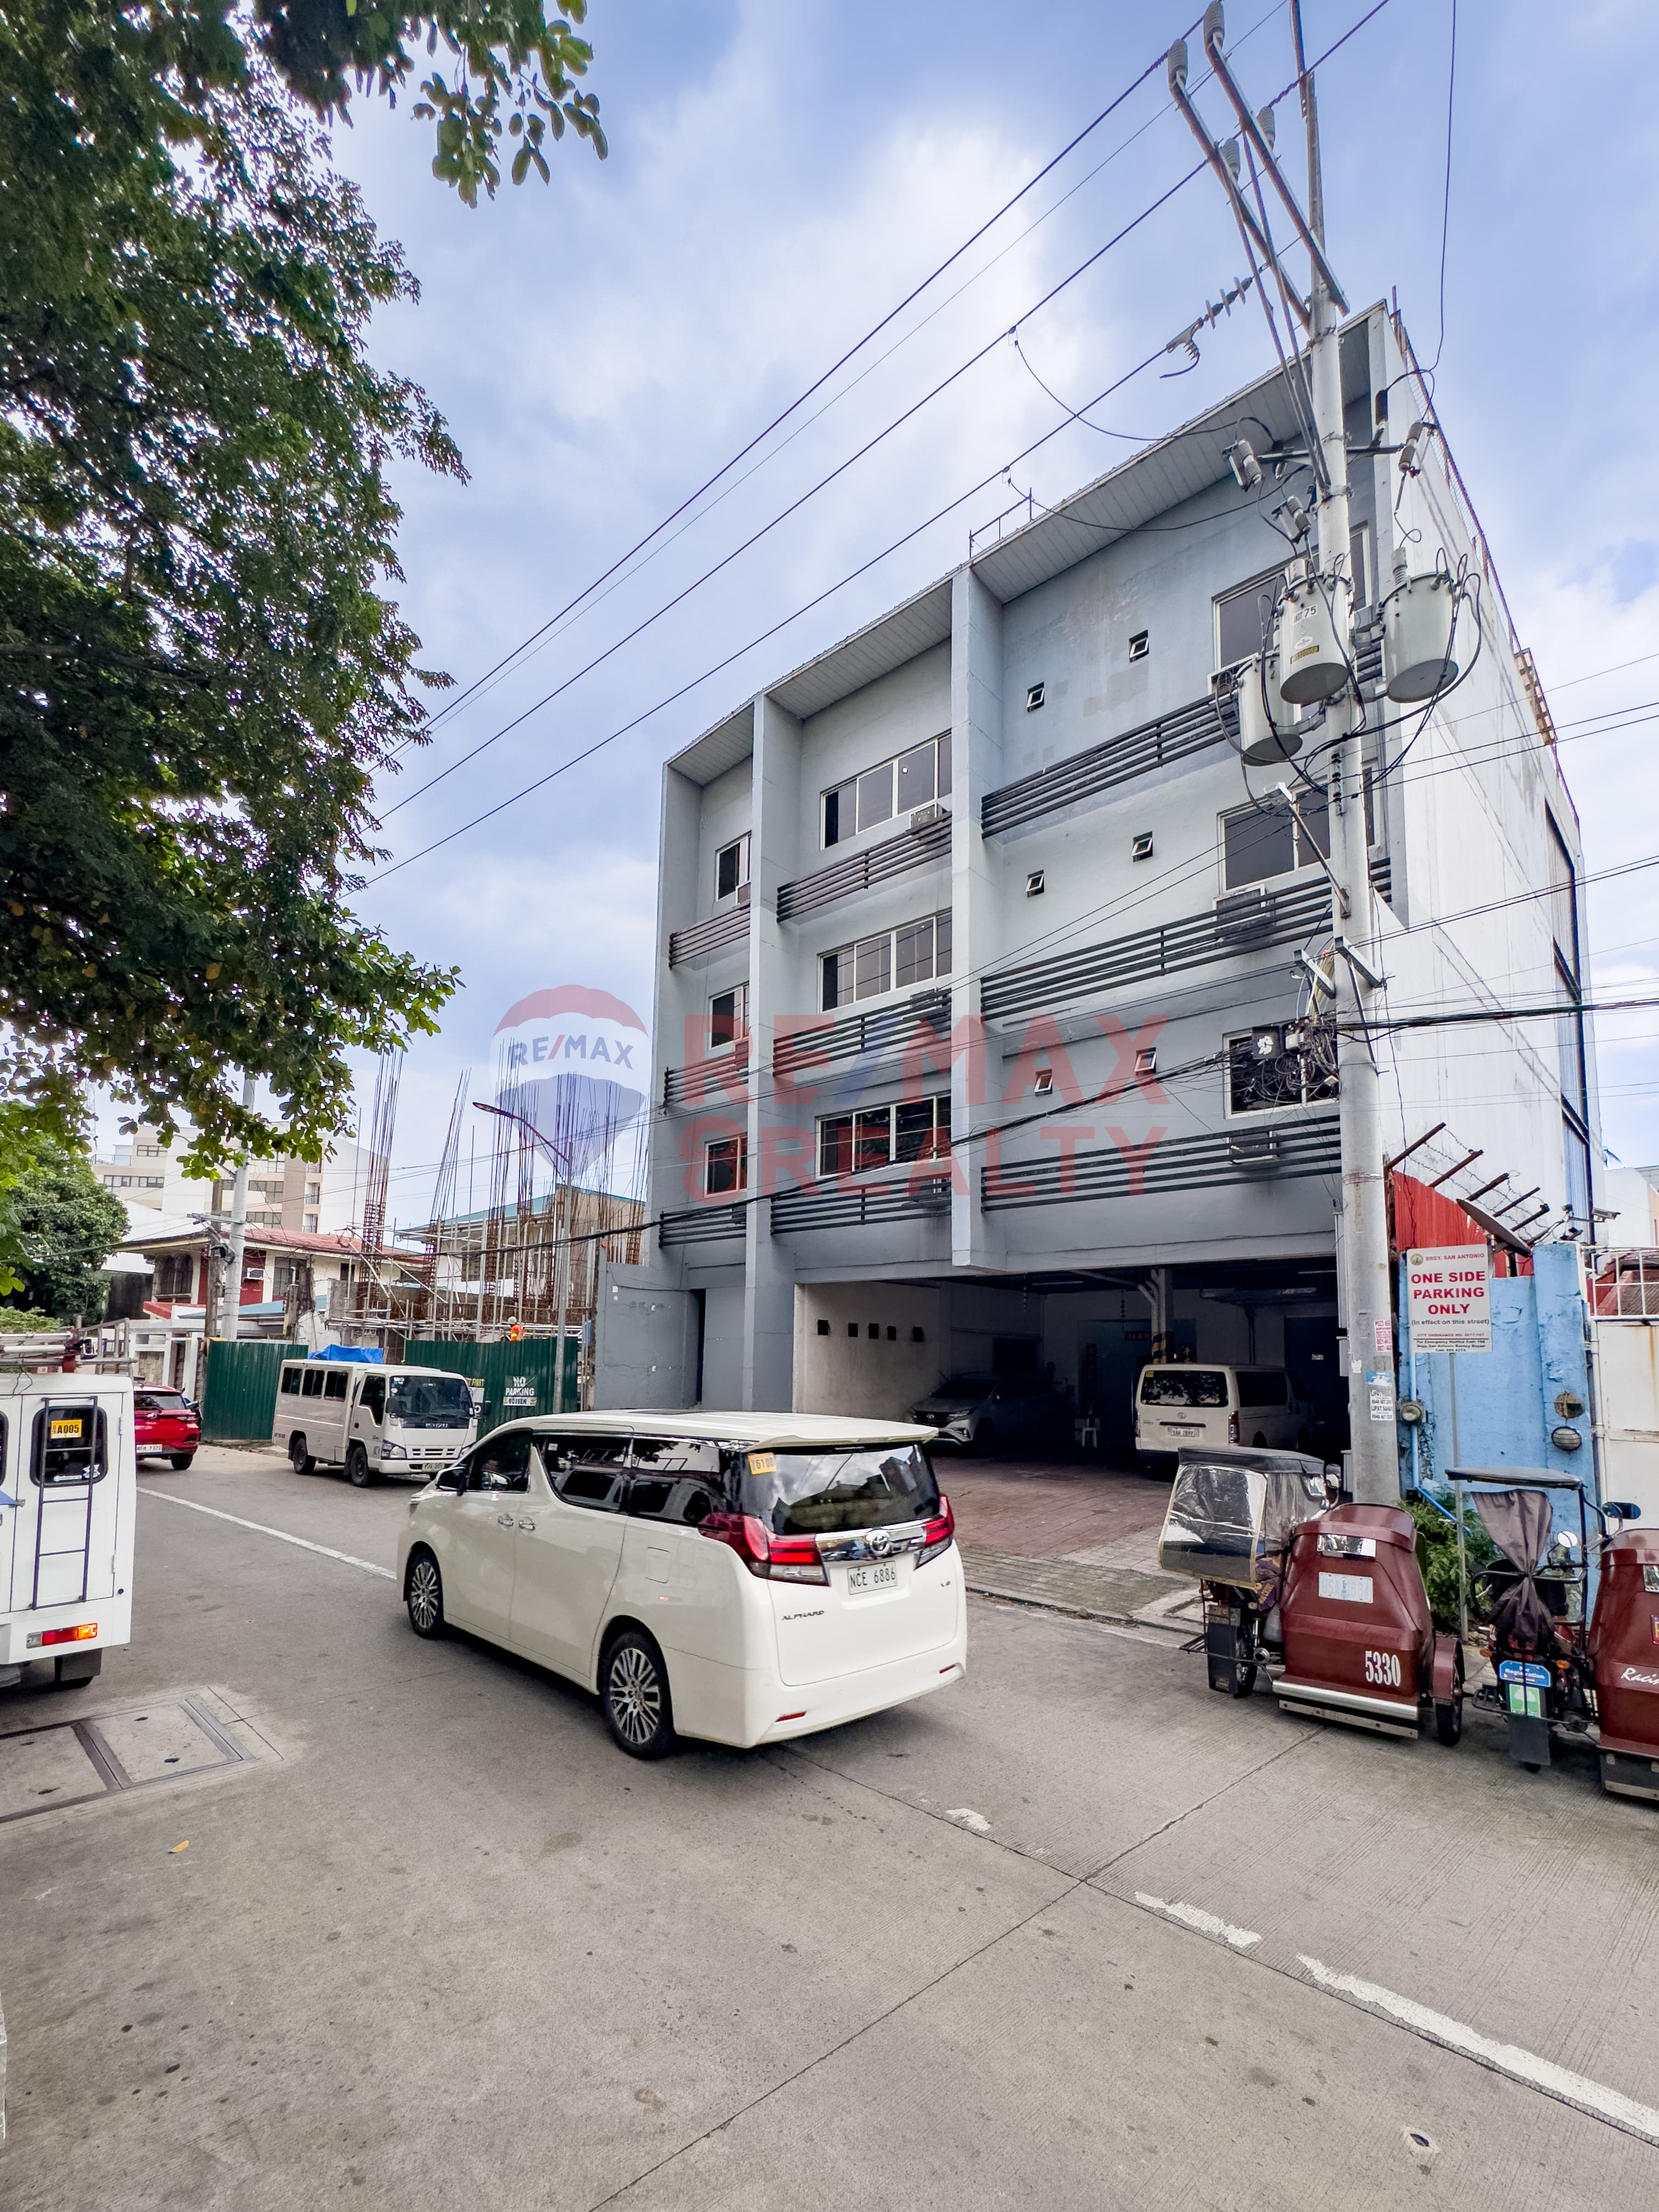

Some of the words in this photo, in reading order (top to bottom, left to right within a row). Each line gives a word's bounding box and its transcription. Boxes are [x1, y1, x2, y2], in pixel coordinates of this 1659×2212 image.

[1304, 606, 1317, 618] 75
[1410, 1273, 1443, 1284] ONE
[1448, 1271, 1486, 1283] SIDE
[1413, 1286, 1485, 1300] PARKING
[1427, 1303, 1471, 1315] ONLY
[512, 1376, 527, 1387] NO
[505, 1387, 535, 1396] PARKING
[57, 1424, 80, 1434] A005
[849, 1571, 868, 1588] NCE
[873, 1566, 896, 1584] 6886
[781, 1610, 825, 1622] ALPHARD
[1364, 1650, 1402, 1688] 5330
